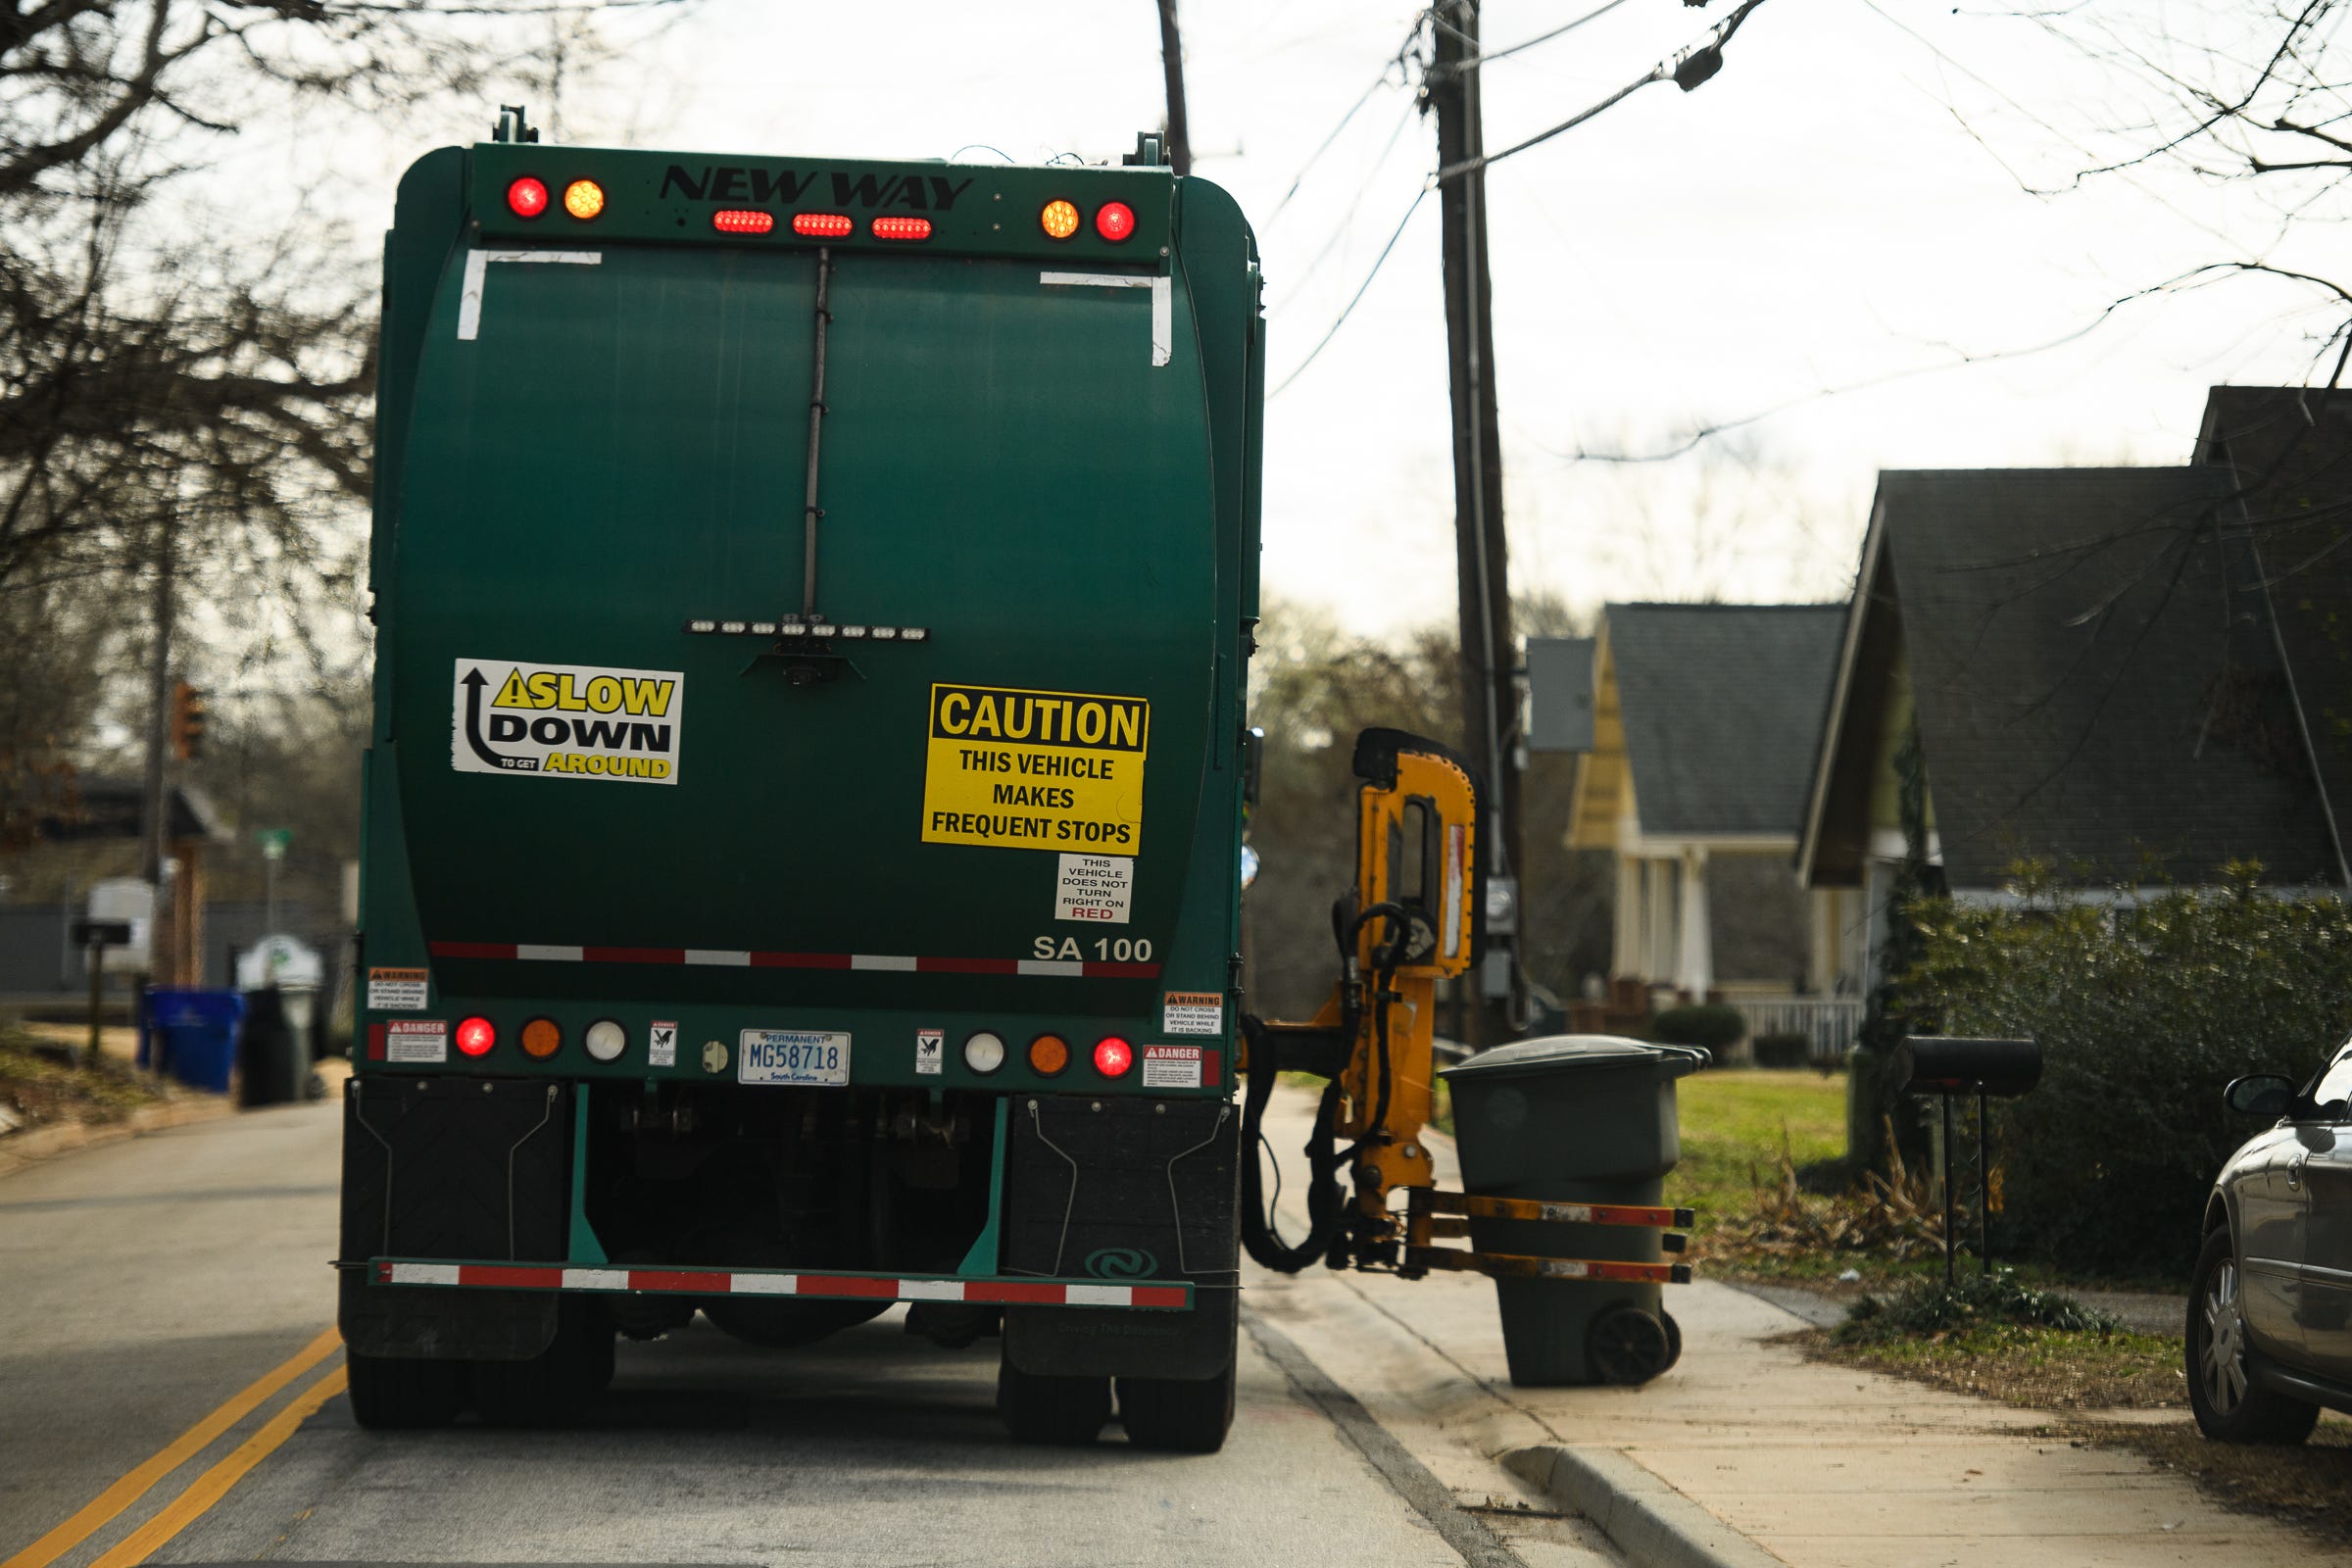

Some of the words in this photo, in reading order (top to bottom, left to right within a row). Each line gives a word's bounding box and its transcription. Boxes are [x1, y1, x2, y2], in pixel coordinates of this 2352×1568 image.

[660, 165, 818, 204] NEW
[830, 172, 975, 212] WAY
[527, 671, 676, 716] SLOW
[940, 692, 1141, 747] CAUTION
[489, 713, 671, 753] DOWN
[501, 758, 515, 767] TO
[516, 759, 536, 769] GET
[542, 752, 671, 779] AROUND
[959, 749, 1011, 772] THIS
[1017, 753, 1114, 780] VEHICLE
[993, 783, 1074, 809] MAKES
[932, 811, 1052, 839] FREQUENT
[1056, 819, 1131, 844] STOPS
[1083, 858, 1111, 867] THIS
[1068, 868, 1123, 878] VEHICLE
[1062, 878, 1098, 887] DOES
[1101, 880, 1128, 889] NOT
[1077, 888, 1112, 898] TURN
[1062, 898, 1102, 906] RIGHT
[1071, 907, 1113, 919] RED
[1033, 936, 1082, 960] SA
[1094, 938, 1152, 961] 100
[1178, 996, 1220, 1005] WARNING
[403, 1023, 445, 1033] DANGER
[765, 1034, 825, 1044] PERMANENT
[750, 1044, 839, 1070] MG58718
[1158, 1048, 1200, 1058] DANGER
